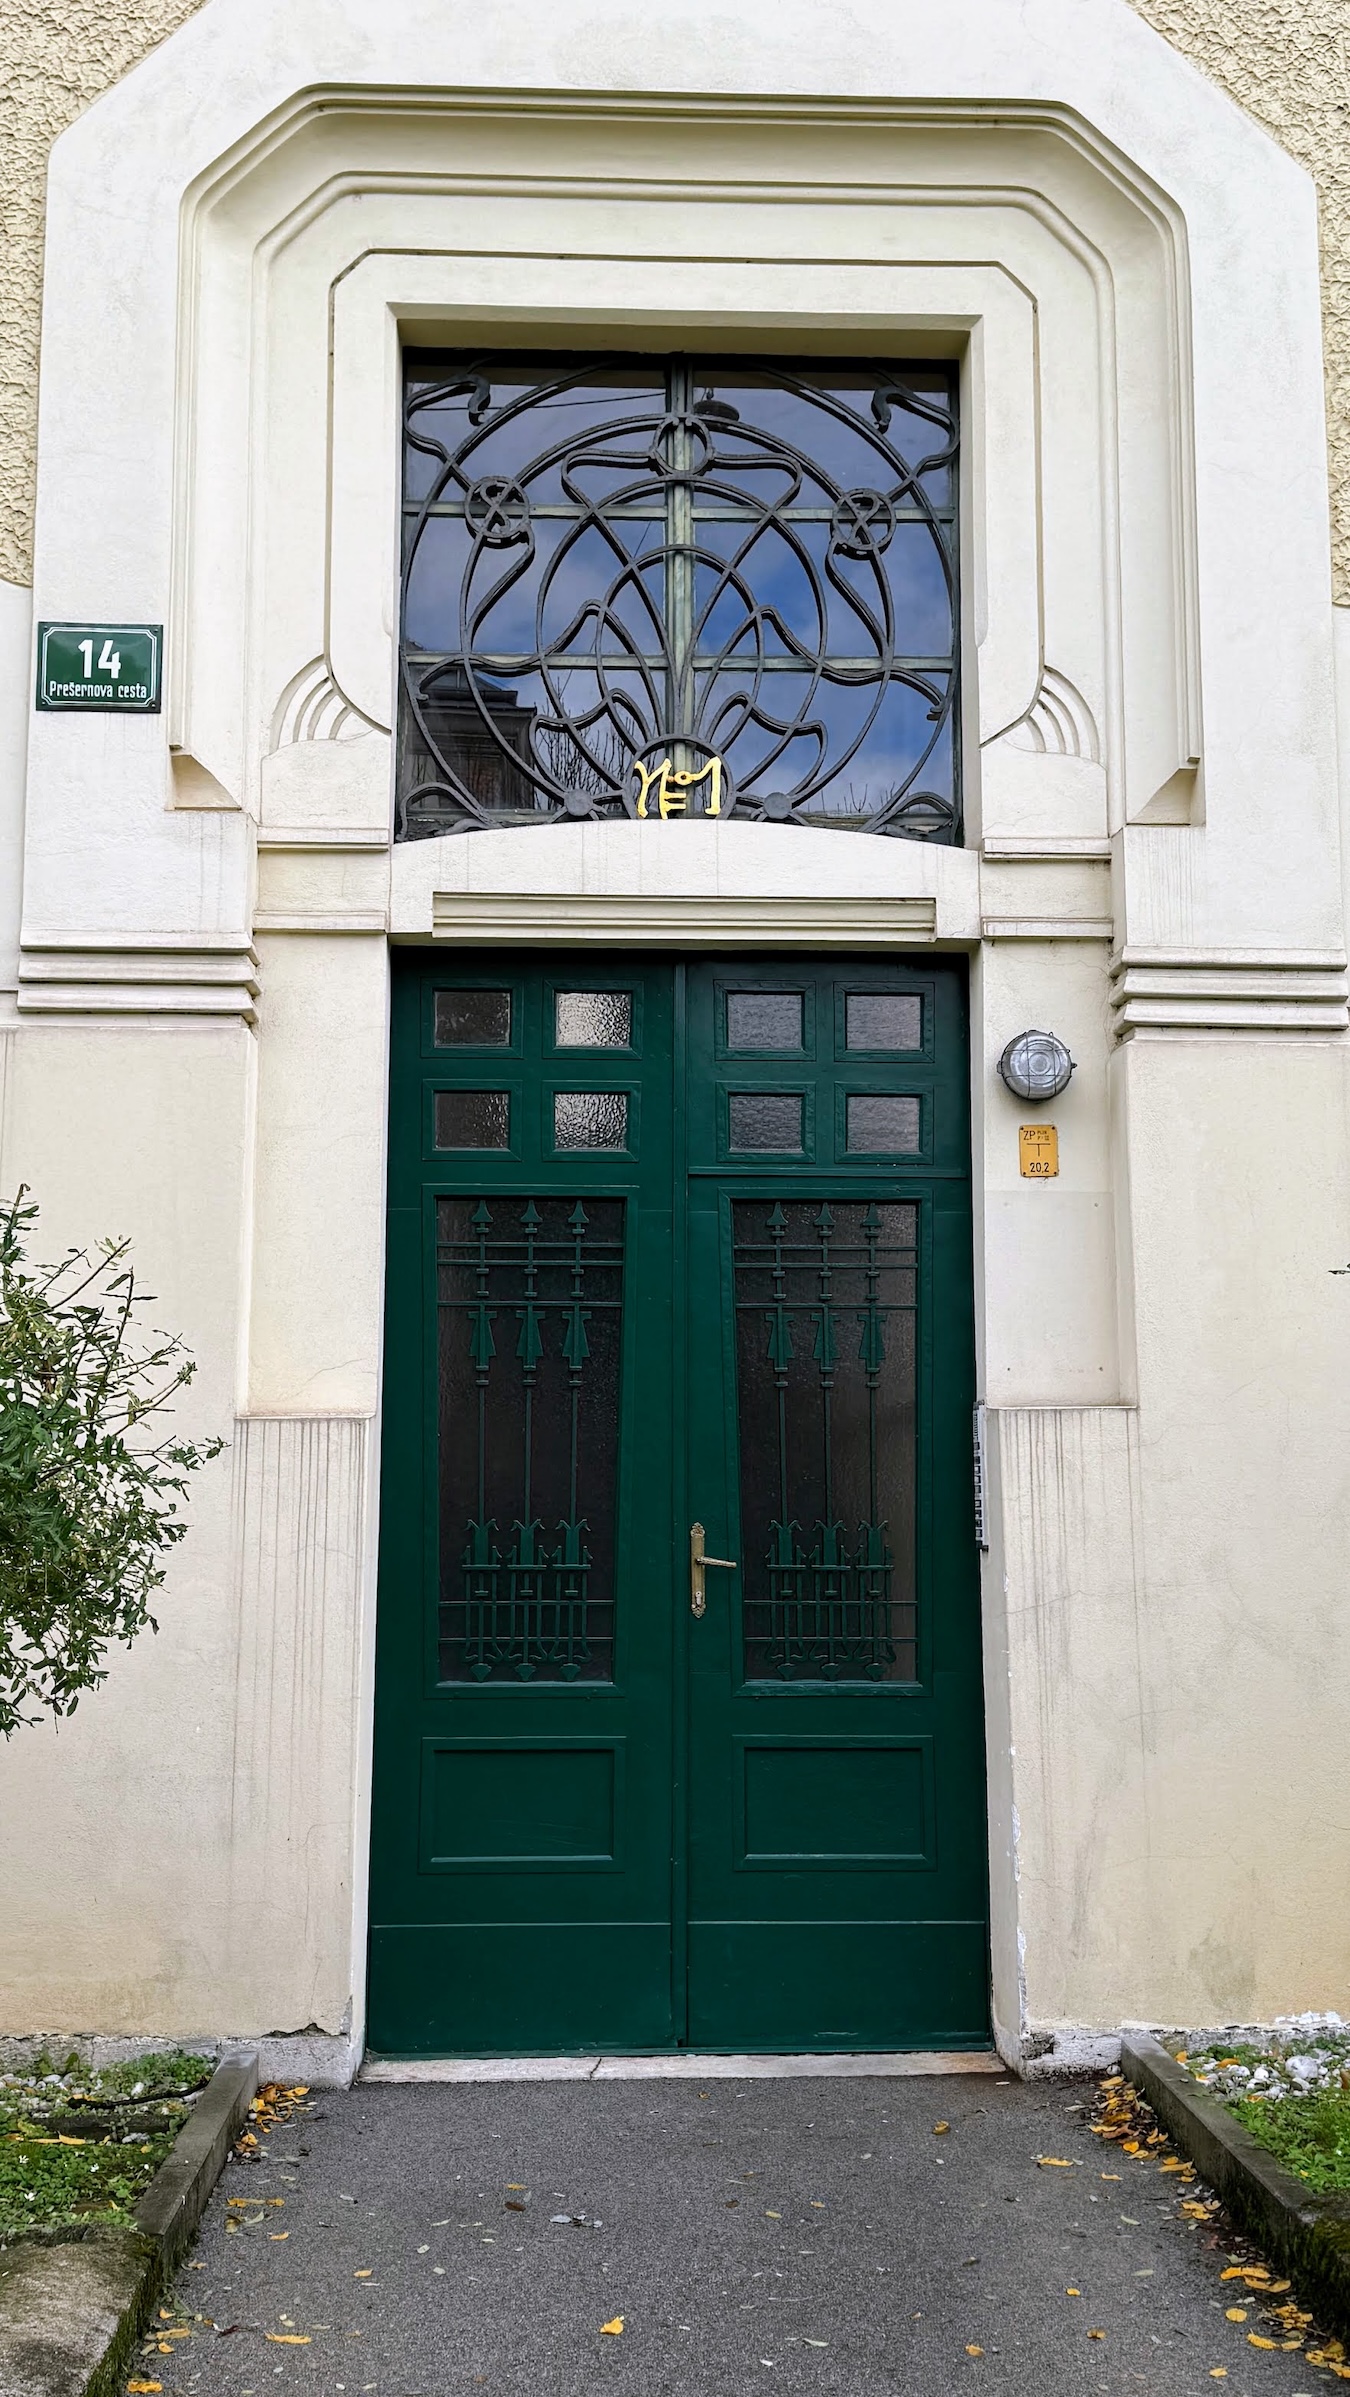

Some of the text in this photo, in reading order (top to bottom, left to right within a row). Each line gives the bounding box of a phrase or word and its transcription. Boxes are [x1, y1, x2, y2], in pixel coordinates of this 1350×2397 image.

[78, 639, 121, 679] 14
[49, 680, 147, 699] Prešernova cesta
[1023, 1130, 1036, 1141] ZP
